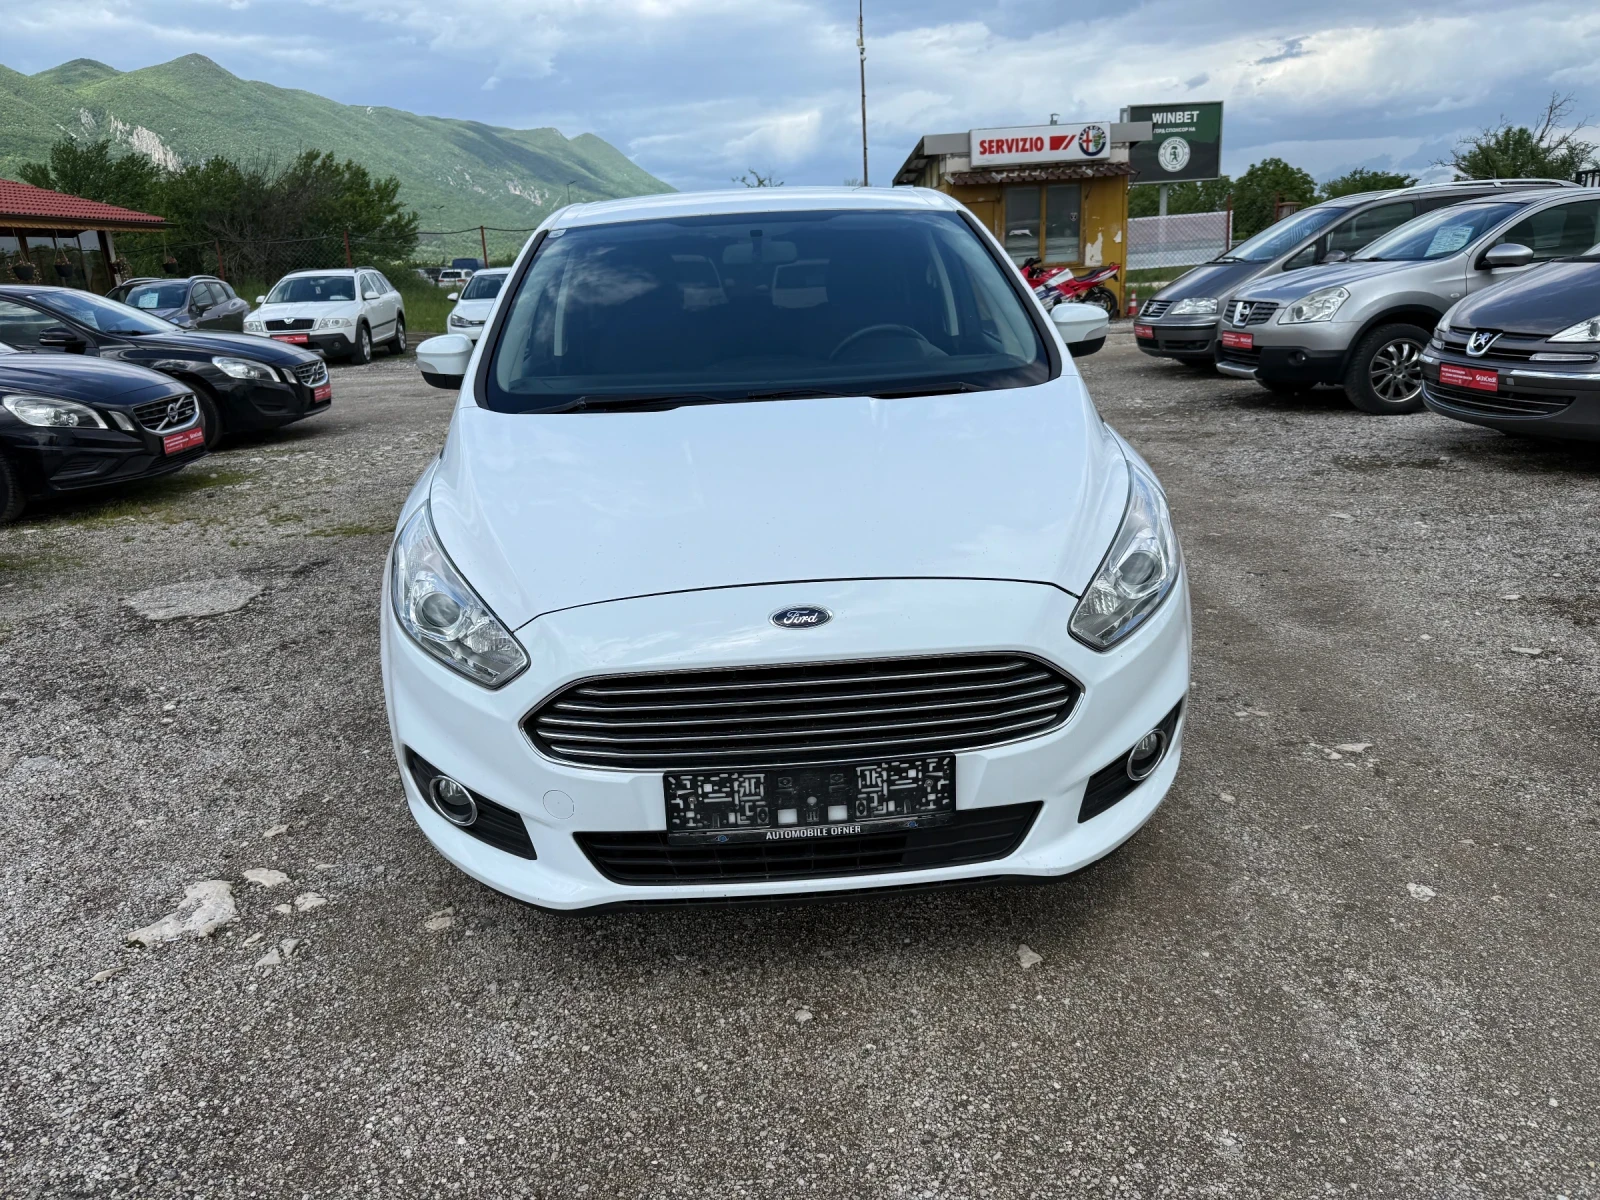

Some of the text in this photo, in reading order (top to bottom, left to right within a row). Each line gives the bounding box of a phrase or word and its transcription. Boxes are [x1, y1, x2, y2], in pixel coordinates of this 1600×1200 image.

[1152, 111, 1199, 124] WINBET
[979, 136, 1044, 155] SERVIZIO
[783, 610, 819, 624] Ford
[766, 825, 861, 840] AUTOMOBILE OFNER
